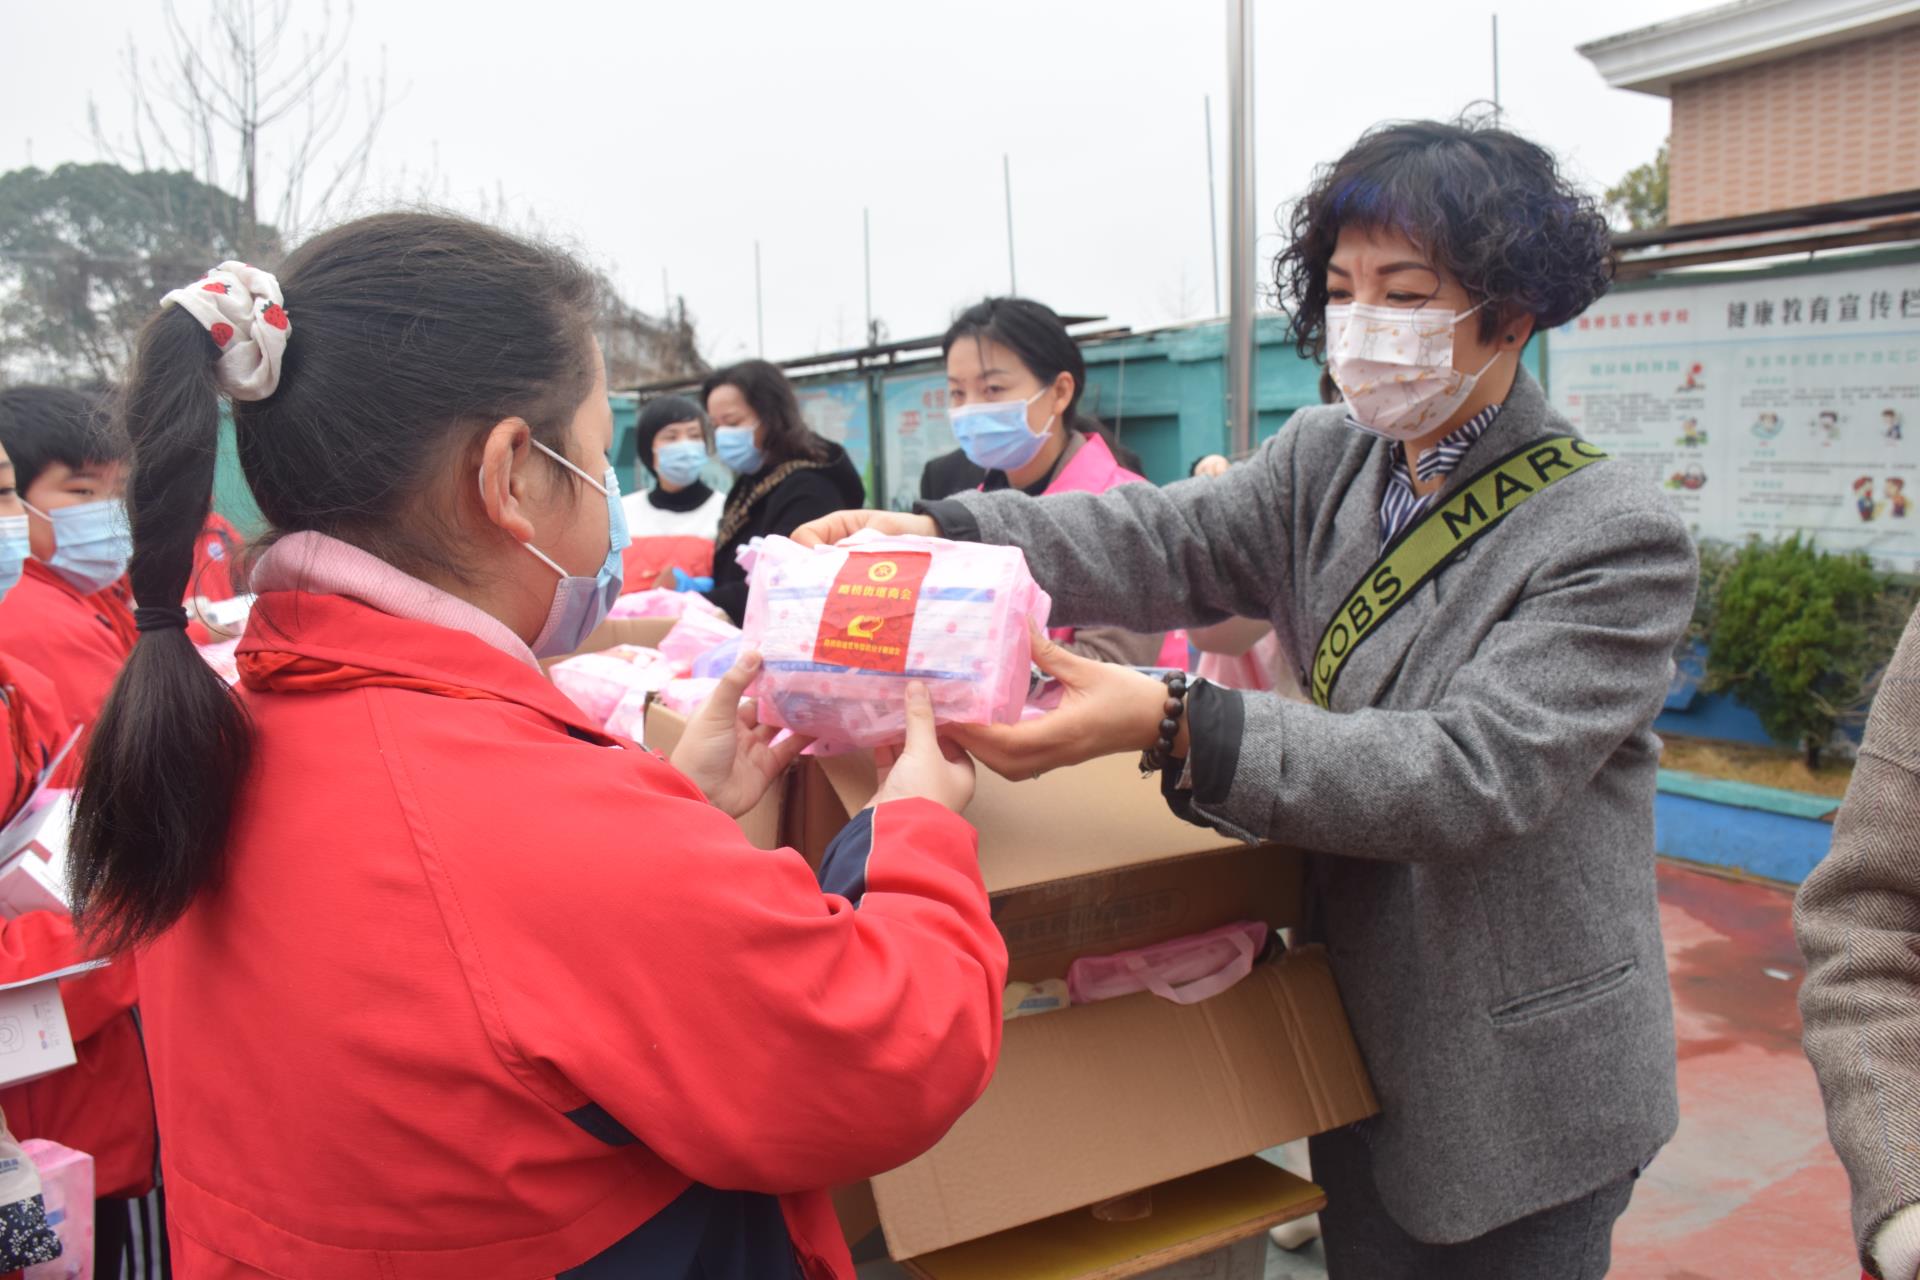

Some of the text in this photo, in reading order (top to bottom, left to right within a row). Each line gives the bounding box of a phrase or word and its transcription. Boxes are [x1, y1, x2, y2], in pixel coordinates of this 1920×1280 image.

[1728, 288, 1920, 328] 健康教育宣传栏
[1441, 438, 1608, 540] MARC
